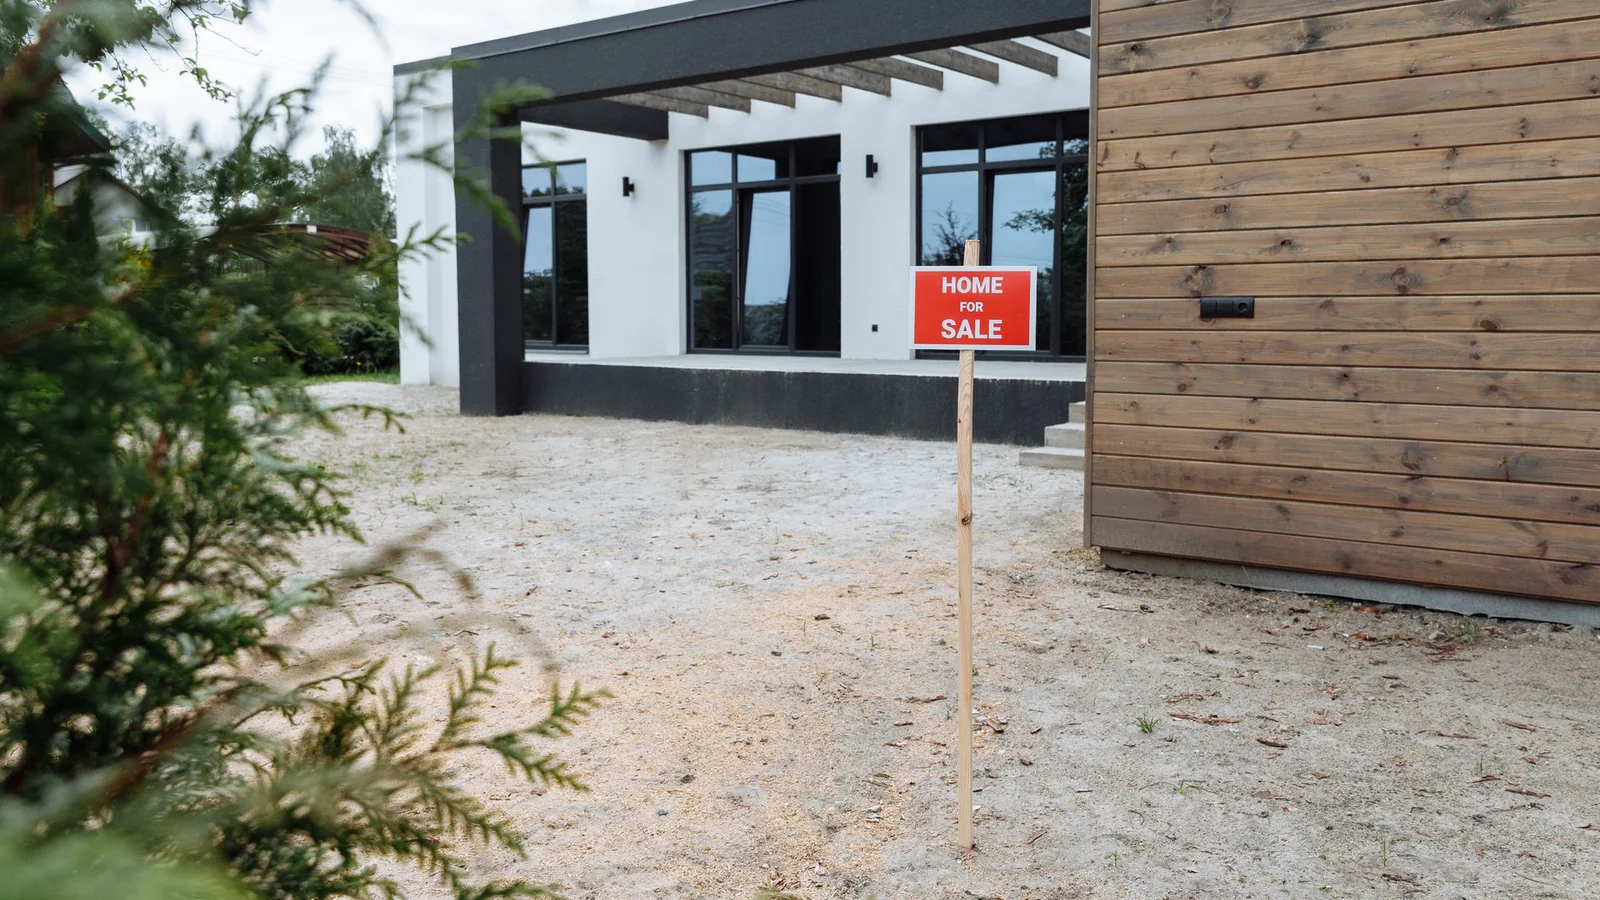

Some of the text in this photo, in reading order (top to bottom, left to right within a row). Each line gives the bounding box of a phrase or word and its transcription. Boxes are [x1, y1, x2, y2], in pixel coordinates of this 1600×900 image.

[941, 276, 1004, 294] HOME
[959, 301, 984, 313] FOR
[940, 318, 1003, 340] SALE
